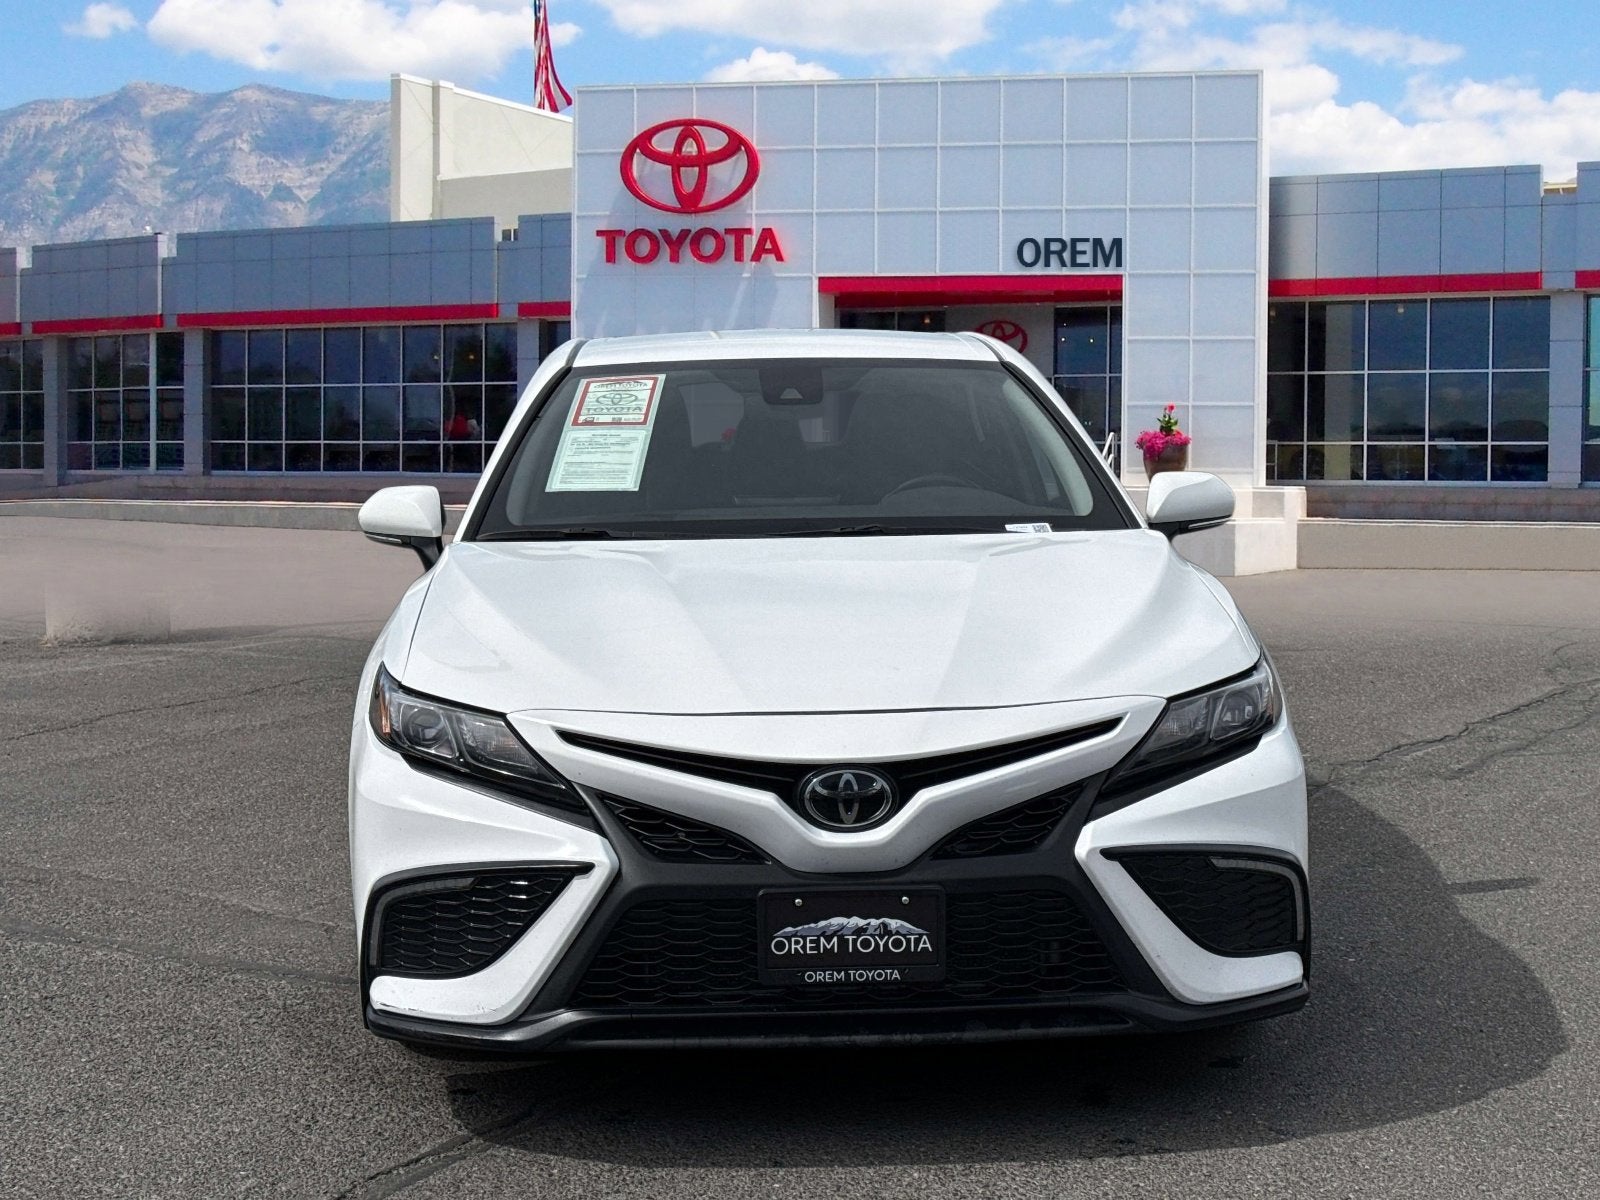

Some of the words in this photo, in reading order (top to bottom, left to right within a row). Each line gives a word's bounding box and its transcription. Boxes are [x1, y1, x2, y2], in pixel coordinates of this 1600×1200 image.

[596, 227, 785, 264] TOYOTA
[1016, 237, 1123, 268] OREM
[771, 936, 838, 955] OREM
[844, 935, 933, 953] TOYOTA
[804, 971, 845, 983] OREM
[848, 969, 901, 982] TOYOTA
